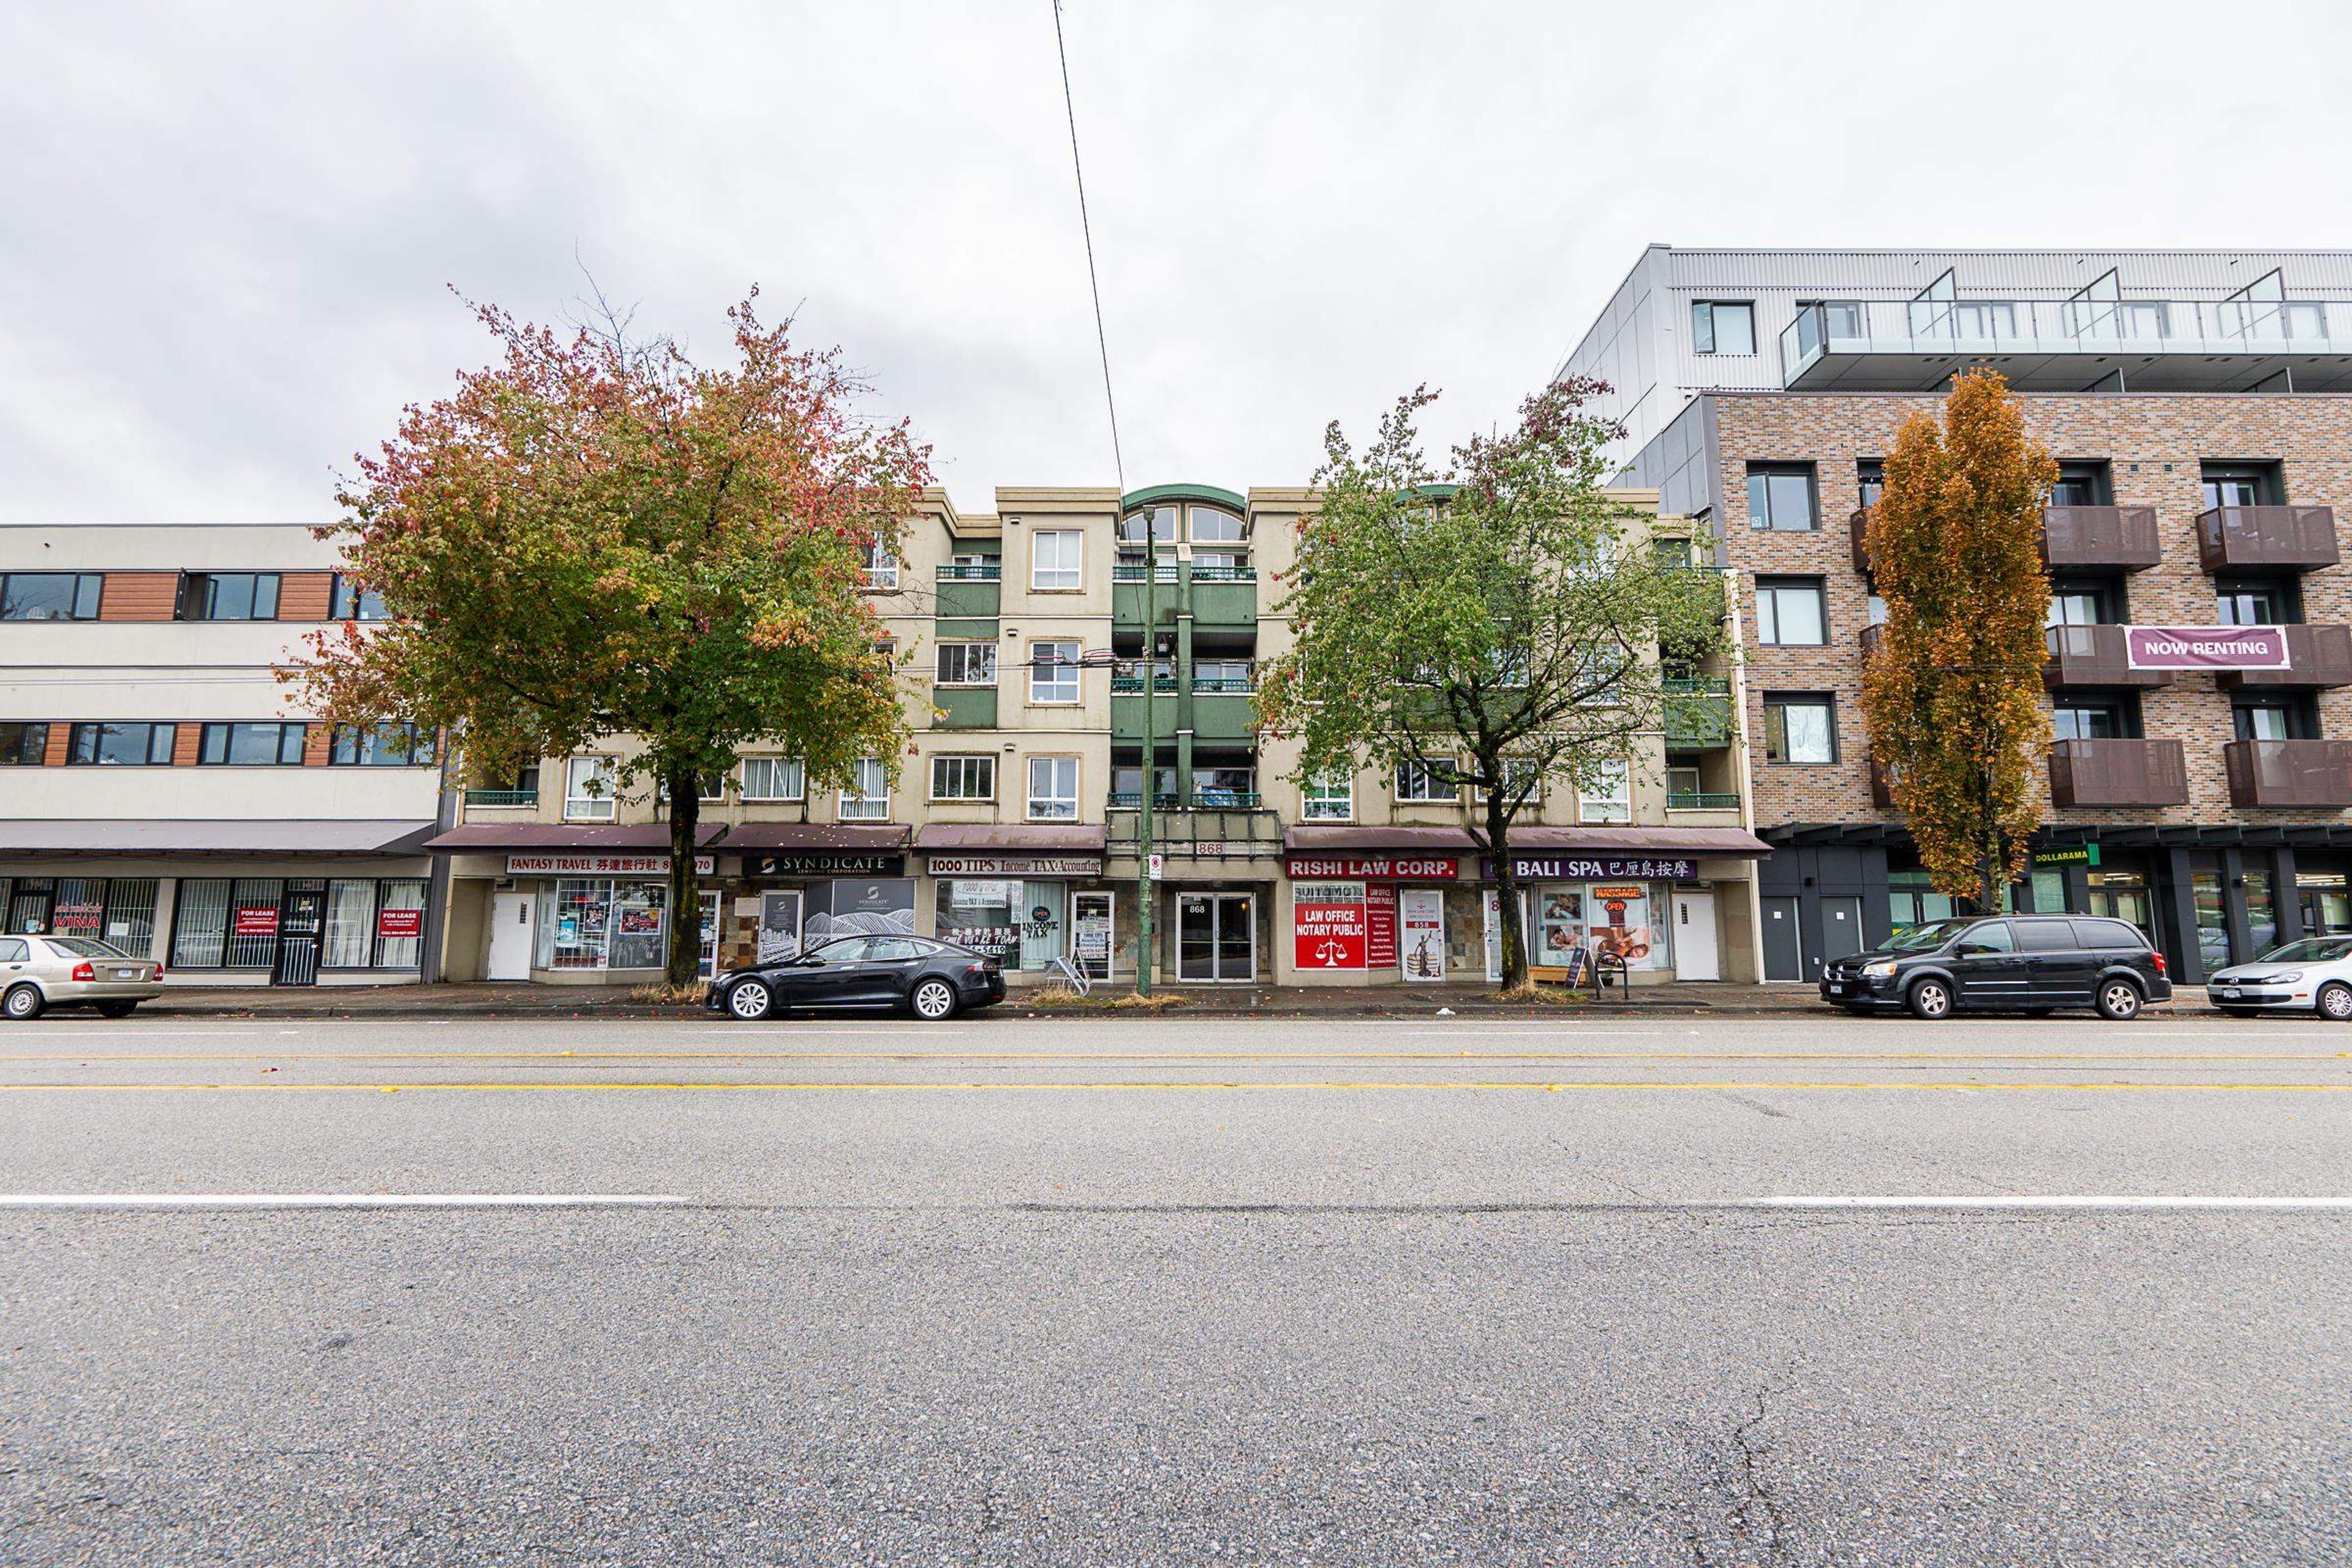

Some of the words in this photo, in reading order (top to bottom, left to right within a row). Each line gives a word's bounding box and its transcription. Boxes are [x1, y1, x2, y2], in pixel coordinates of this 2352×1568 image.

[2145, 642, 2189, 655] NOW
[2192, 642, 2269, 655] RENTING
[1199, 843, 1223, 853] 868
[2036, 851, 2088, 862] DOLLARAMA
[511, 859, 553, 870] FANTASY
[557, 859, 592, 870] TRAVEL
[783, 858, 884, 869] SYNDICATE
[931, 860, 962, 871] 1000
[964, 860, 995, 872] TIPS
[1000, 860, 1030, 872] Income
[1033, 860, 1055, 872] TAX
[1058, 859, 1100, 874] Accounting
[1290, 861, 1342, 875] RISHI
[1349, 861, 1390, 875] LAW
[1396, 861, 1453, 875] CORP.
[1517, 861, 1559, 876] BALI
[1569, 861, 1604, 876] SPA
[1609, 860, 1689, 877] 巴厘島按摩
[1596, 888, 1640, 897] MASSAGE
[55, 916, 100, 928] VINA
[1305, 910, 1323, 922] LAW
[1325, 910, 1355, 922] OFFICE
[1022, 921, 1058, 930] INCOME
[1297, 924, 1331, 936] NOTARY
[1332, 924, 1363, 936] PUBLIC
